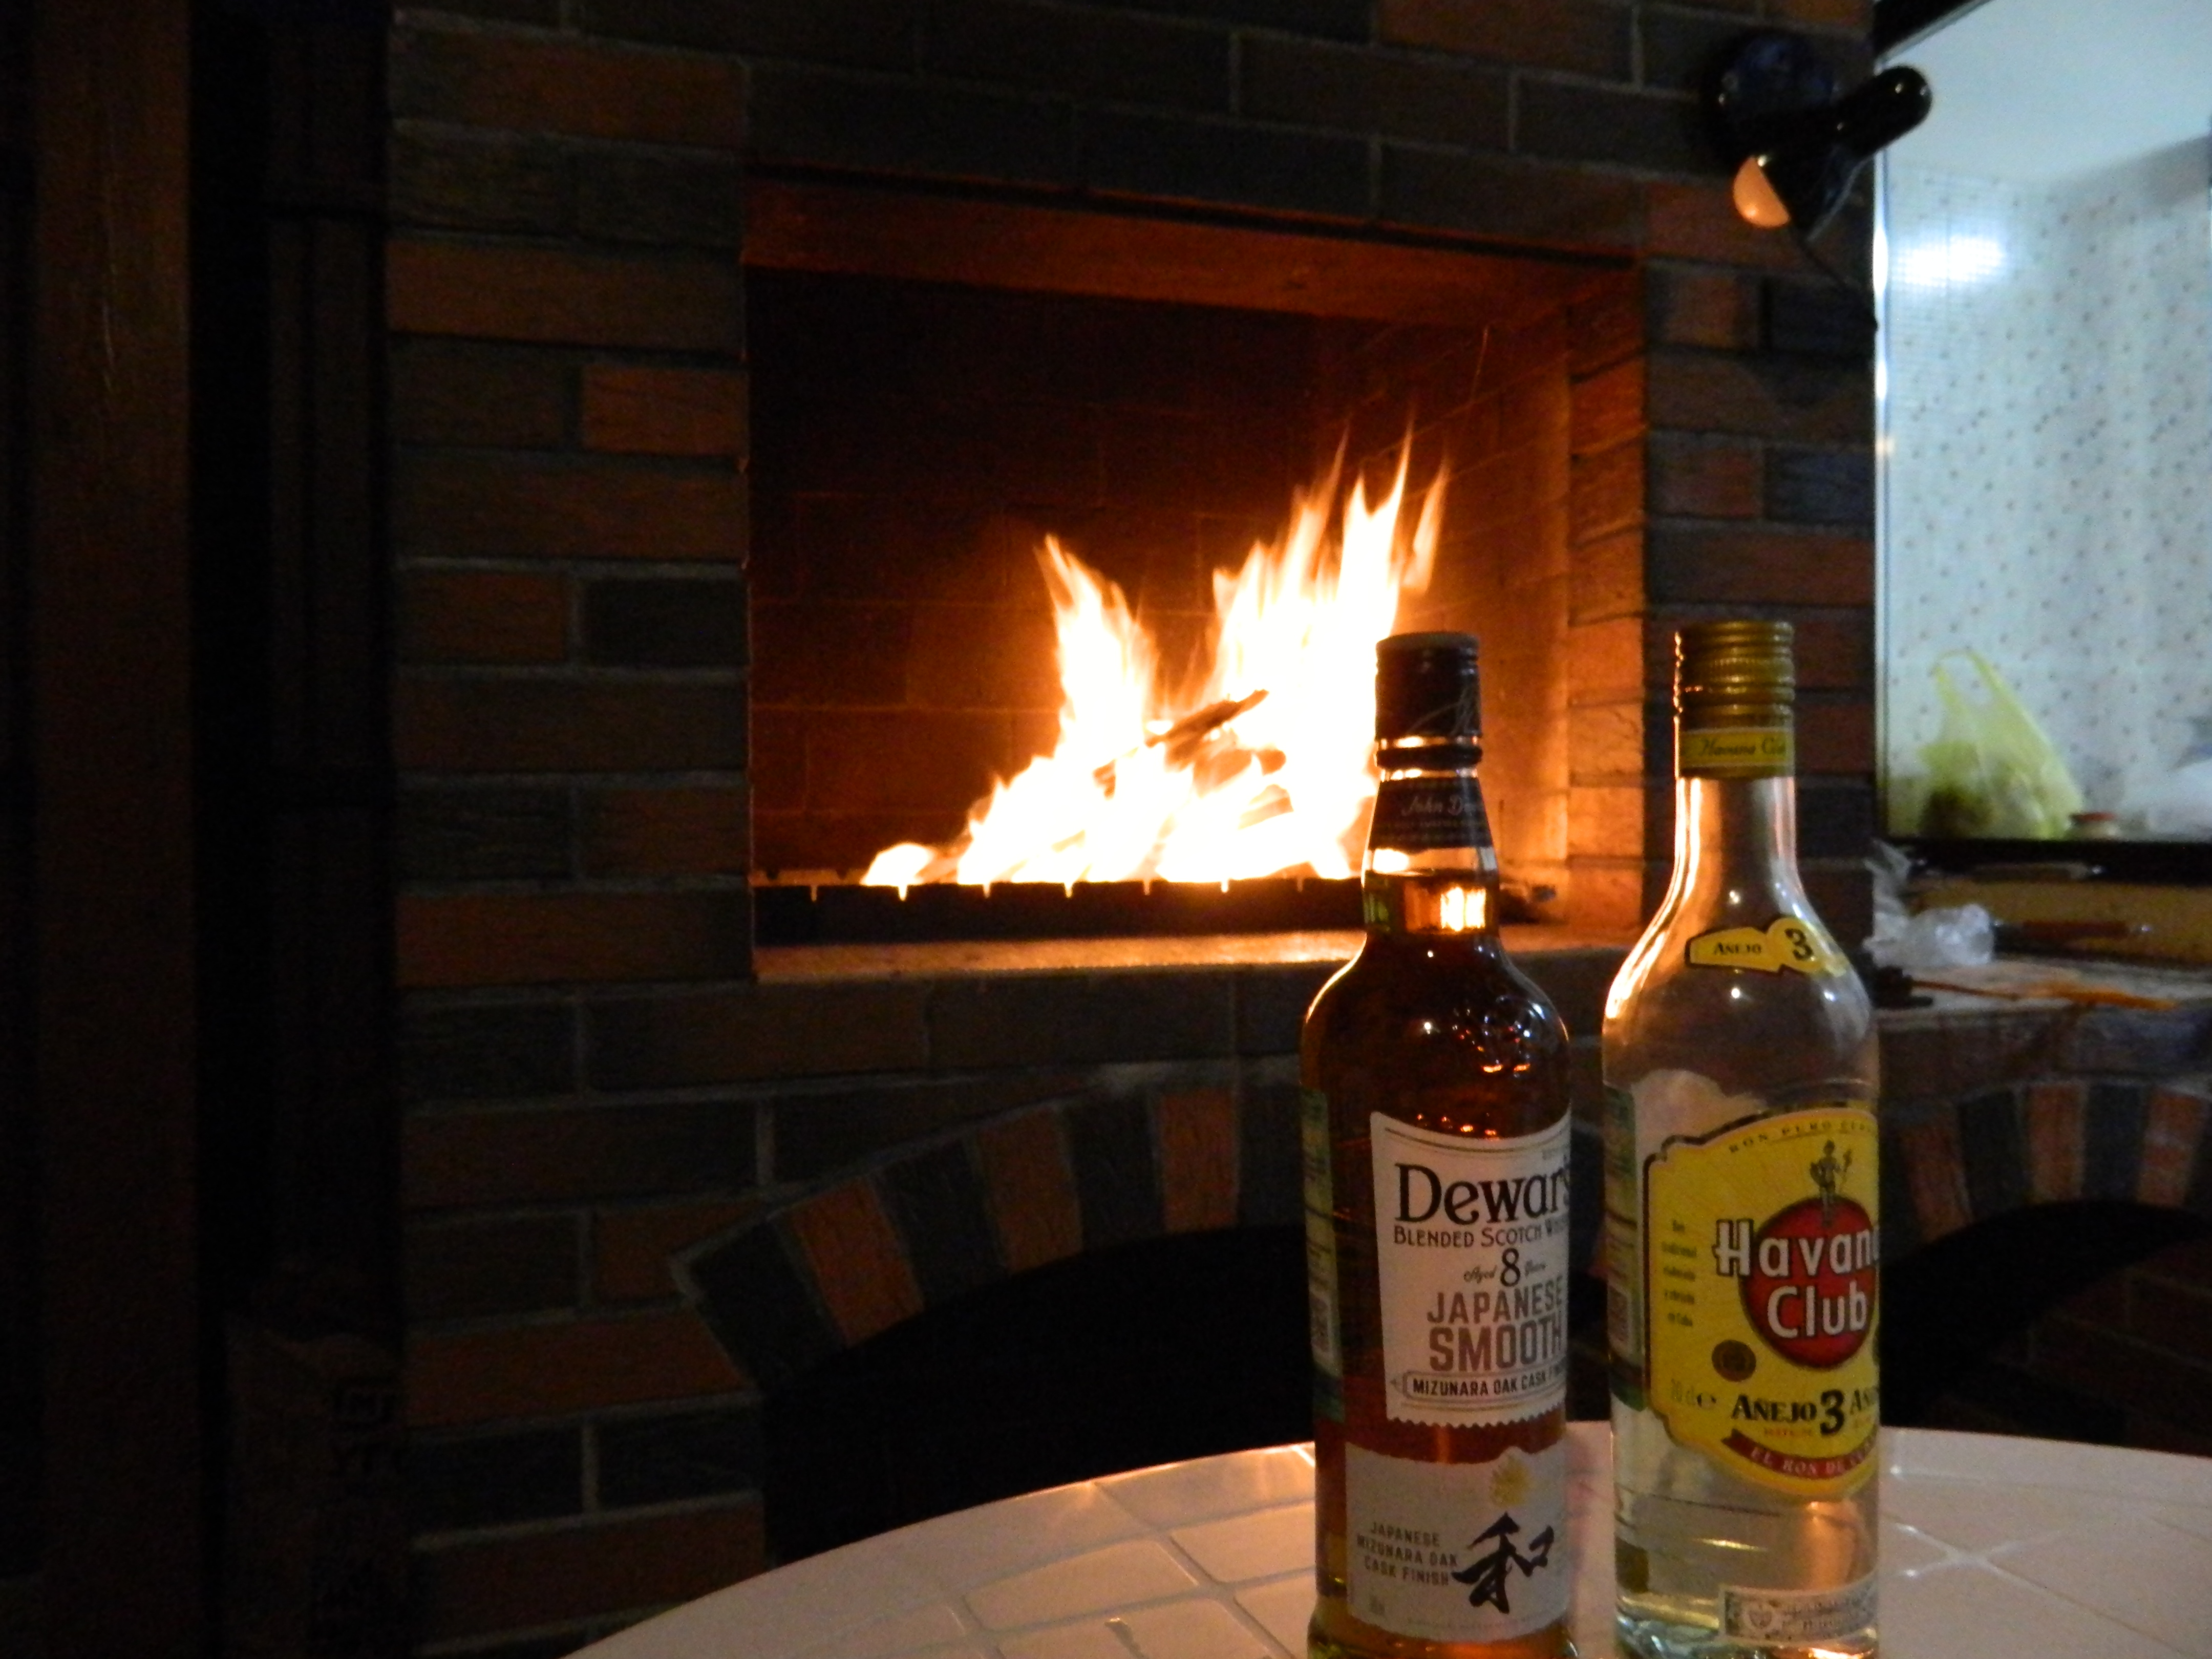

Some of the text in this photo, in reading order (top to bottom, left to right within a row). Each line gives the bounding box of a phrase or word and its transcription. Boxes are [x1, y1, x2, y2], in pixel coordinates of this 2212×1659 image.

[1785, 928, 1815, 961] 3
[1394, 1226, 1474, 1248] BLENDED
[1481, 1224, 1542, 1248] SCOTCH
[1500, 1247, 1521, 1287] 8
[1427, 1275, 1563, 1324] JAPANESE
[1767, 1279, 1868, 1339] Club
[1429, 1311, 1562, 1372] SMOOTH
[1413, 1378, 1489, 1397] MIZUNARA
[1494, 1376, 1517, 1394] OAK
[1819, 1389, 1845, 1438] 3
[1356, 1534, 1458, 1567] MIZUNARA OAK
[1371, 1521, 1440, 1547] JAPANESE
[1364, 1555, 1449, 1586] CASK FINISH
[1451, 1511, 1555, 1614] 和
